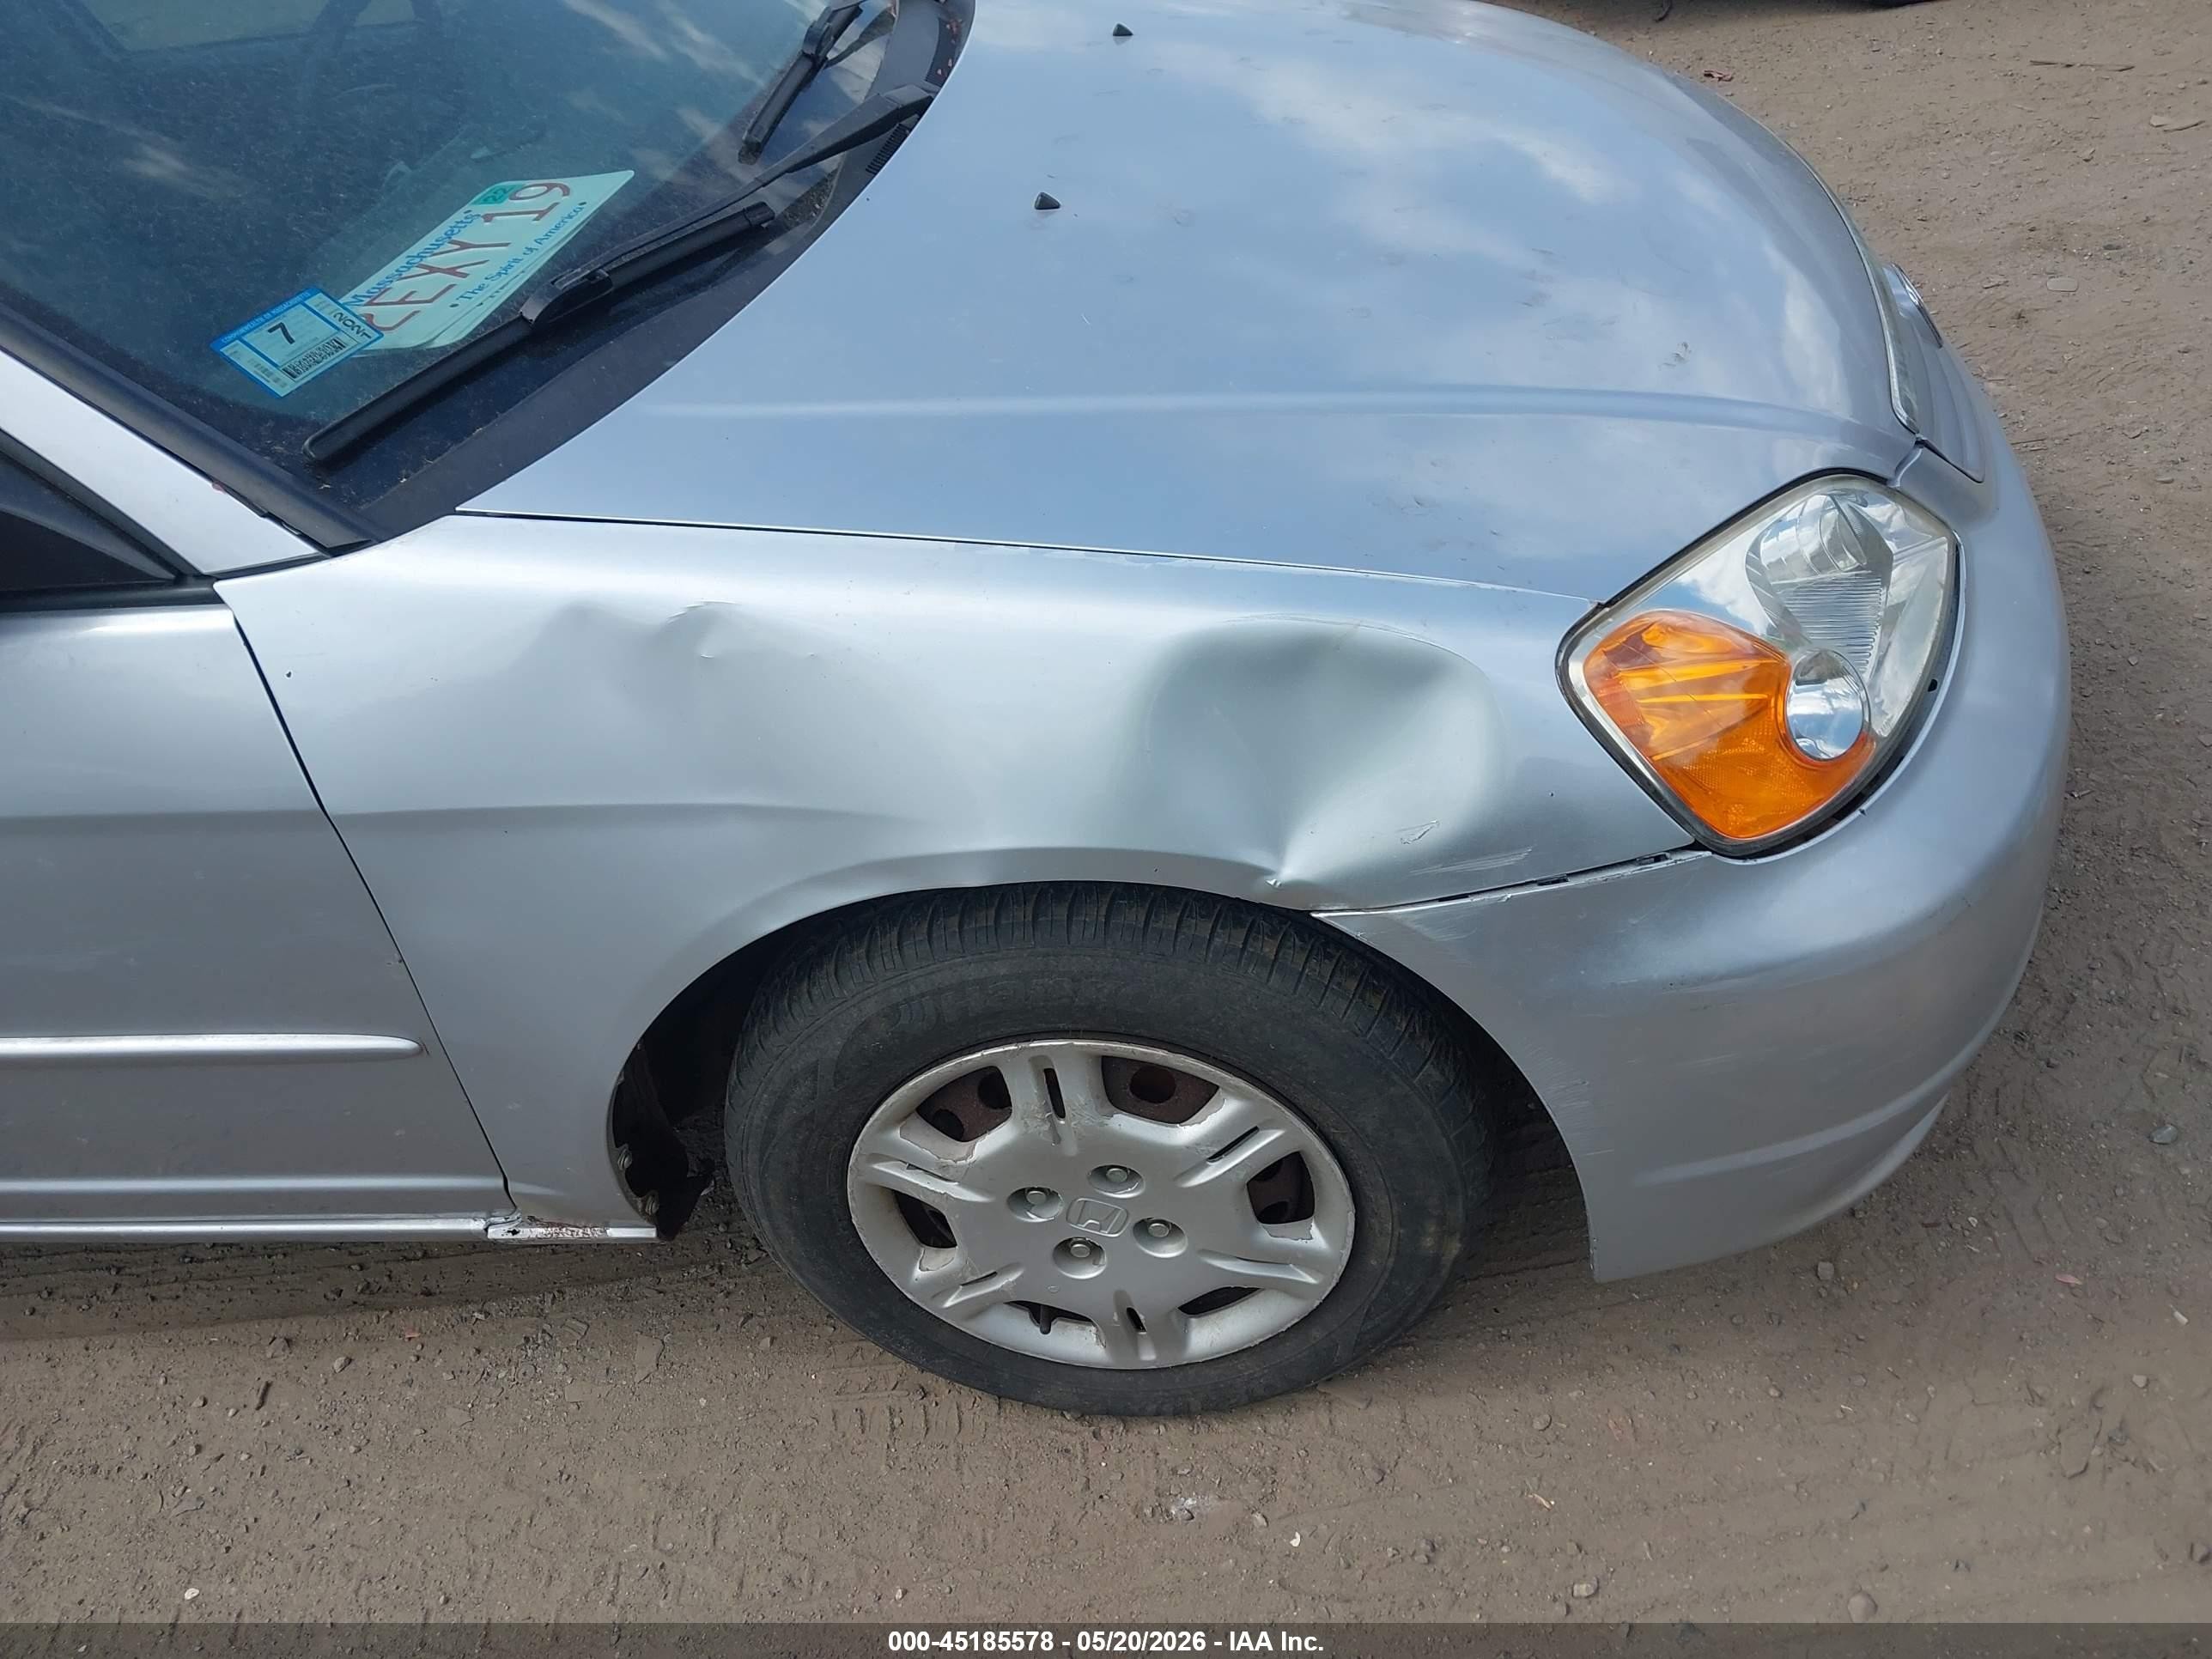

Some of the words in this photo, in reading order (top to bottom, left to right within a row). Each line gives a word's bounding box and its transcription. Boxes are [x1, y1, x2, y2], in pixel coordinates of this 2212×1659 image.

[481, 182, 571, 223] 19
[343, 214, 482, 307] Massachusetts
[456, 283, 490, 301] The
[484, 258, 524, 282] Spirit
[522, 246, 539, 256] of
[533, 204, 585, 246] America
[267, 321, 295, 344] 7
[332, 311, 372, 340] 2021
